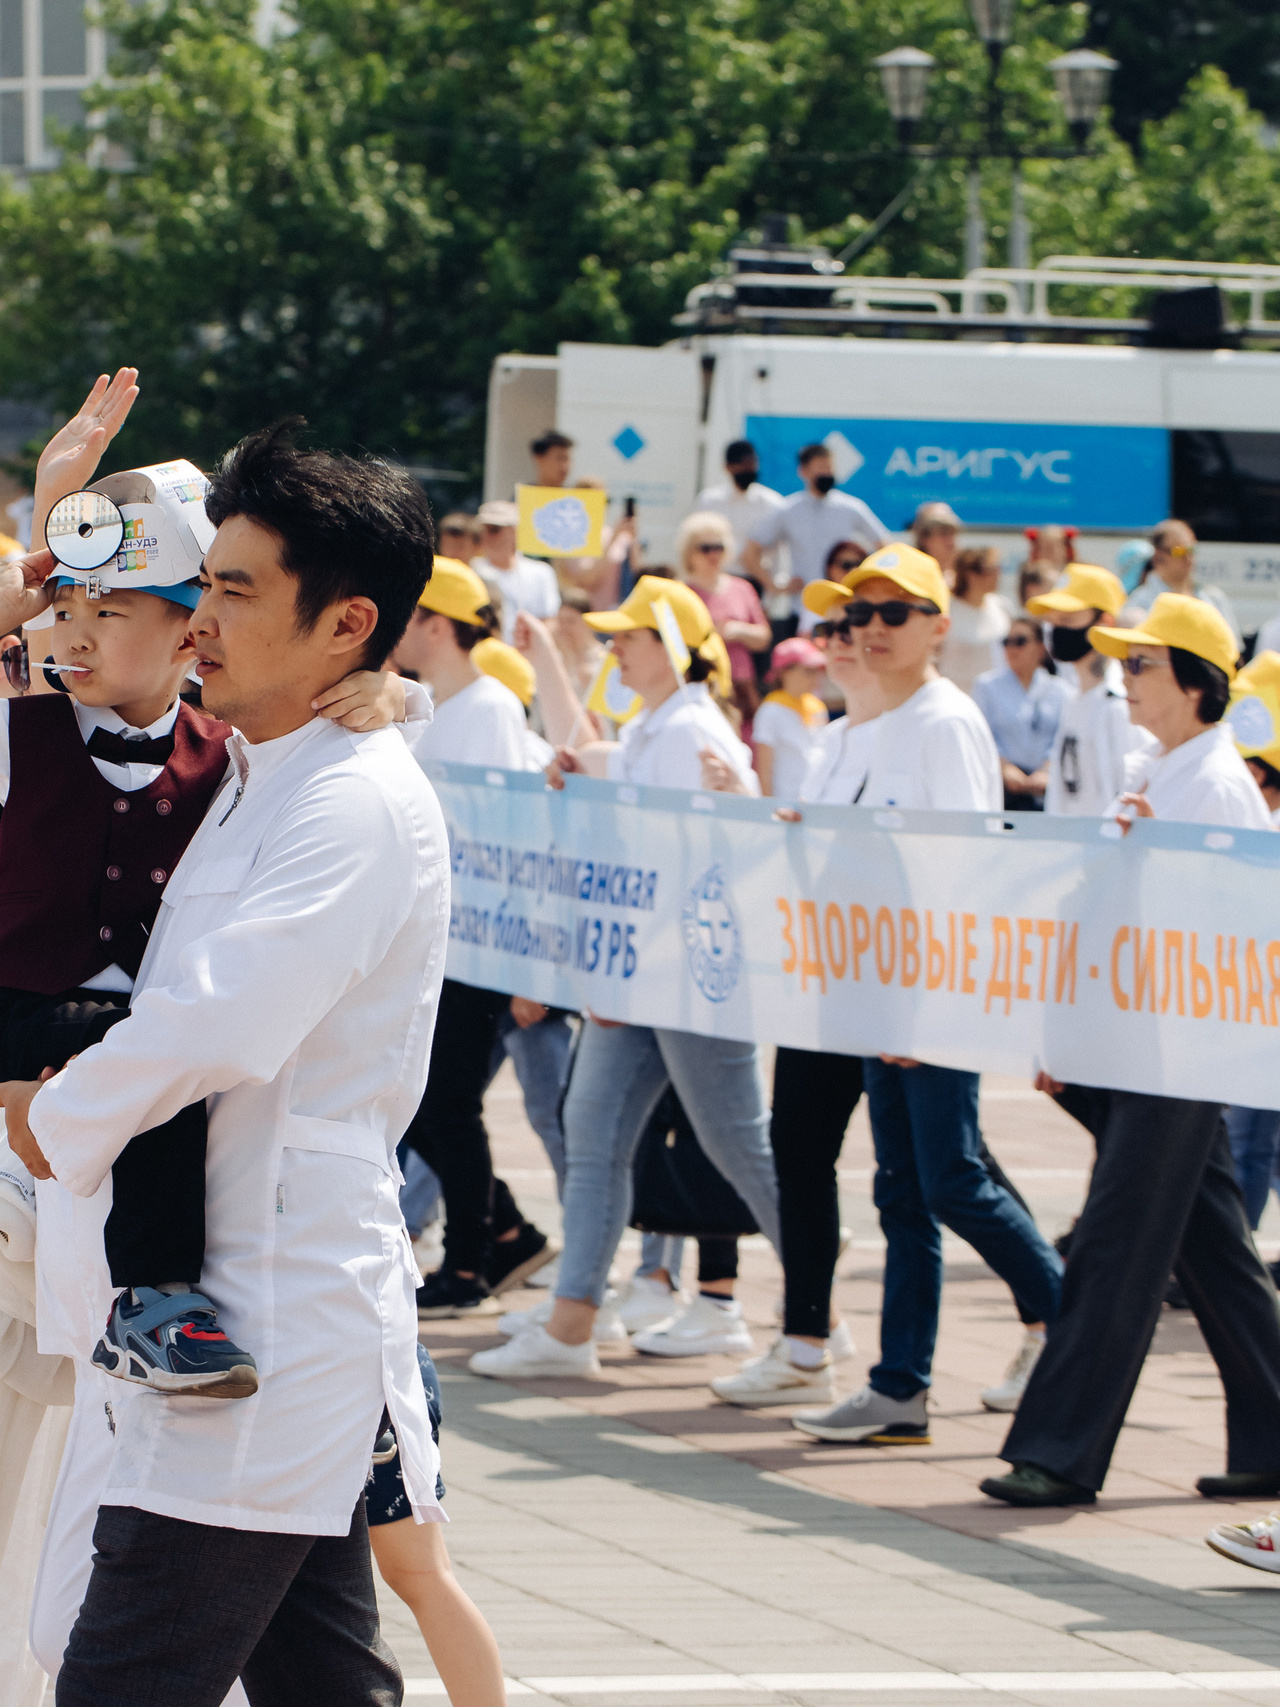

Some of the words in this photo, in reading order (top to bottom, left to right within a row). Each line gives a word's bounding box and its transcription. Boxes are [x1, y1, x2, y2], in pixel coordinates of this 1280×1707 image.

[884, 446, 1071, 484] АРИГУС
[776, 897, 978, 996] ЗДОРОВЫЕ
[984, 915, 1079, 1017] ДЕТИ
